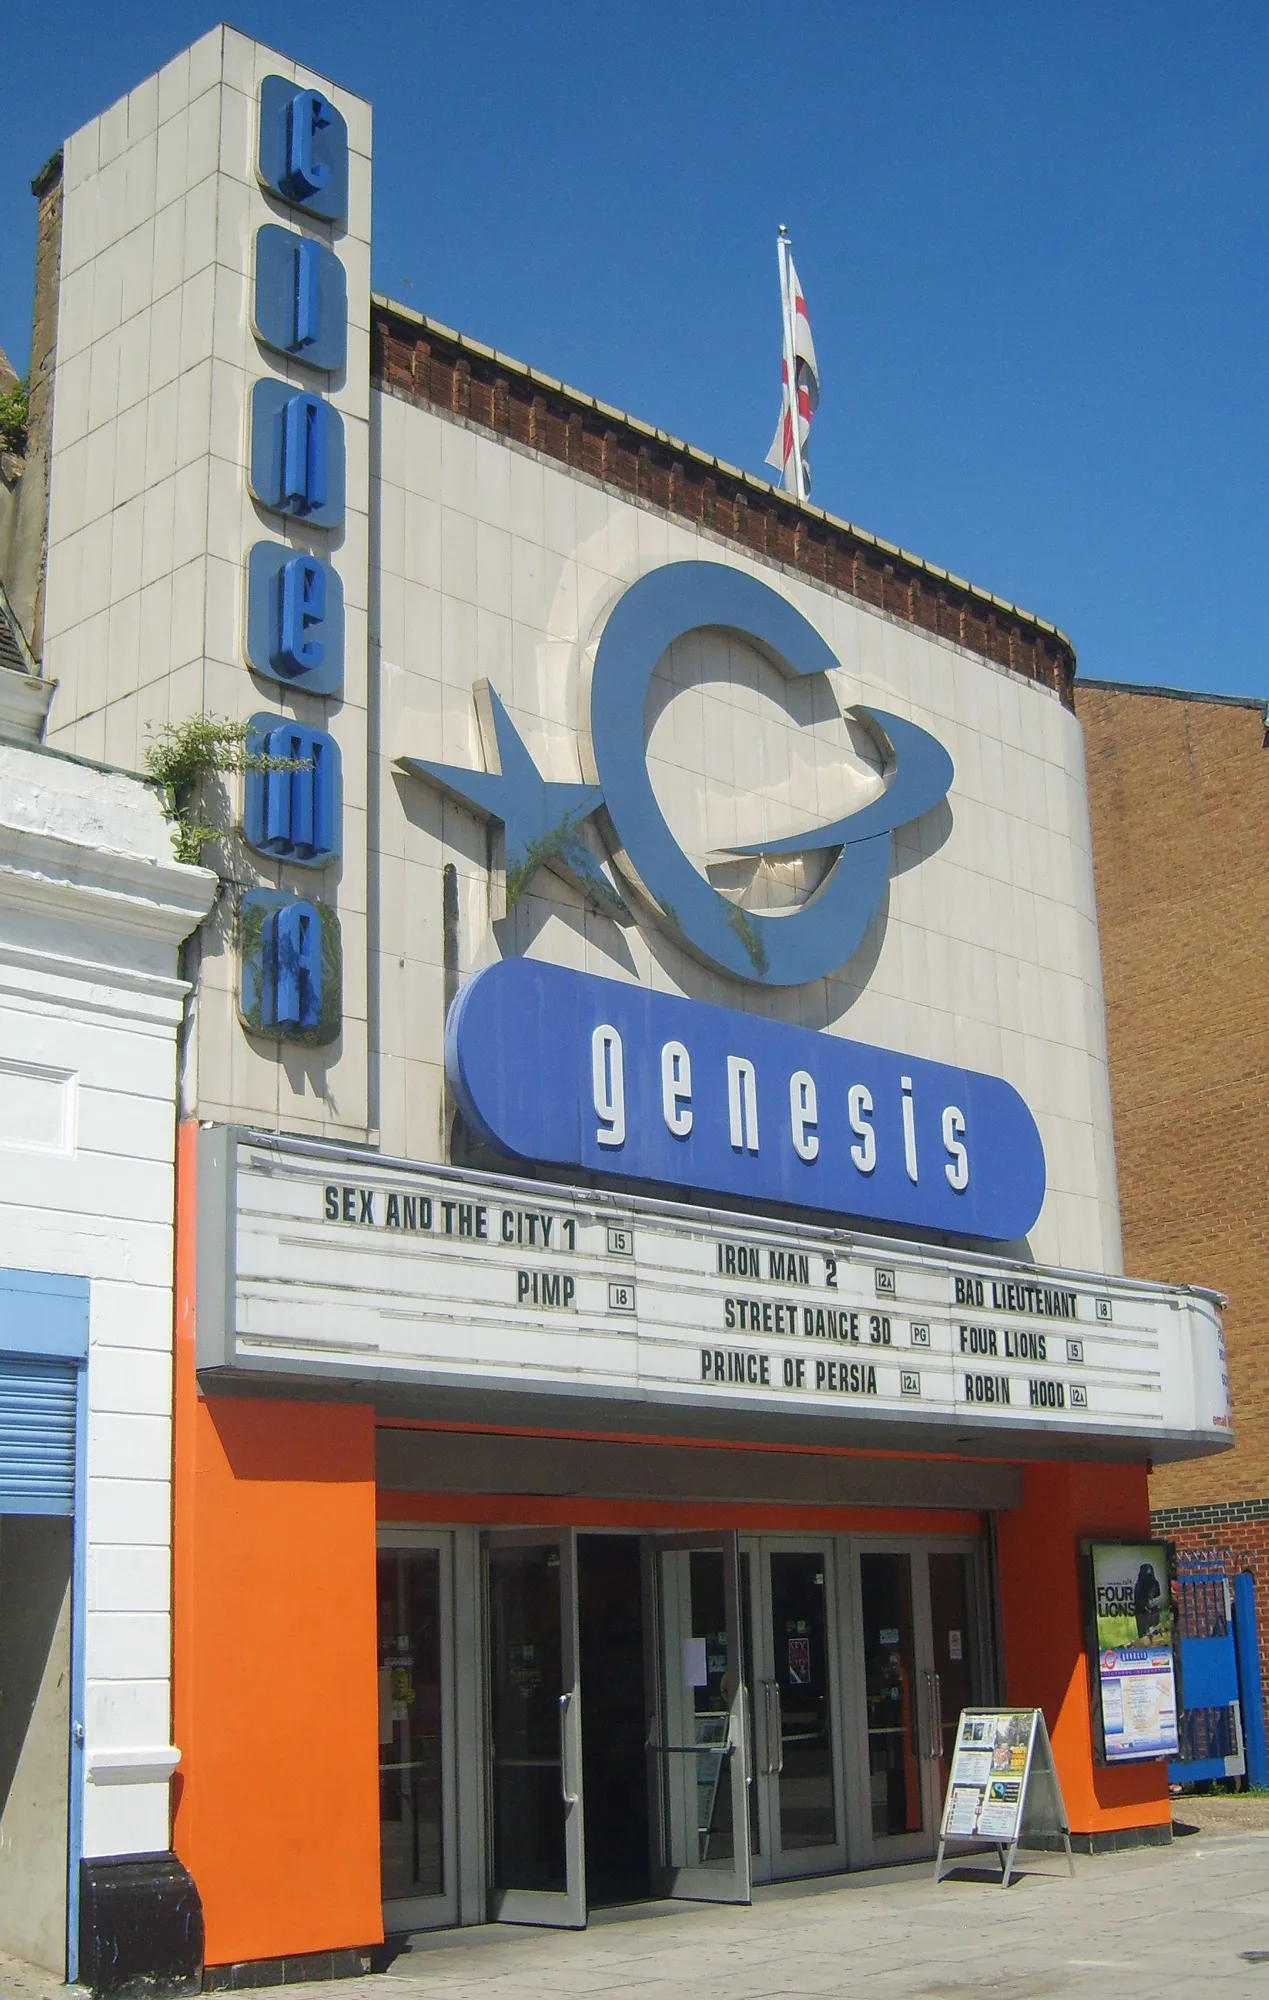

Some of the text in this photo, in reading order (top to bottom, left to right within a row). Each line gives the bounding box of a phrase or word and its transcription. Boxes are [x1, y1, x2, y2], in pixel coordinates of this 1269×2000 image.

[592, 1024, 969, 1190] genesis
[325, 1186, 626, 1250] SEX AND THE CITY 1 15
[718, 1243, 760, 1278] IRON
[769, 1250, 809, 1285] MAN
[825, 1259, 838, 1288] 2
[517, 1270, 628, 1307] PIMP 18
[955, 1277, 1109, 1318] BAD LIEUTENANT 18
[869, 1315, 891, 1345] 3D
[914, 1327, 927, 1341] PG
[959, 1326, 1079, 1360] FOUR LIONS 15
[701, 1350, 770, 1385] PRINCE
[783, 1358, 805, 1387] OF
[816, 1360, 877, 1394] PERSIA
[965, 1374, 1010, 1404] ROBIN
[1029, 1379, 1064, 1408] HOOD
[1098, 1586, 1133, 1602] FOUR
[1098, 1602, 1136, 1618] LIONS
